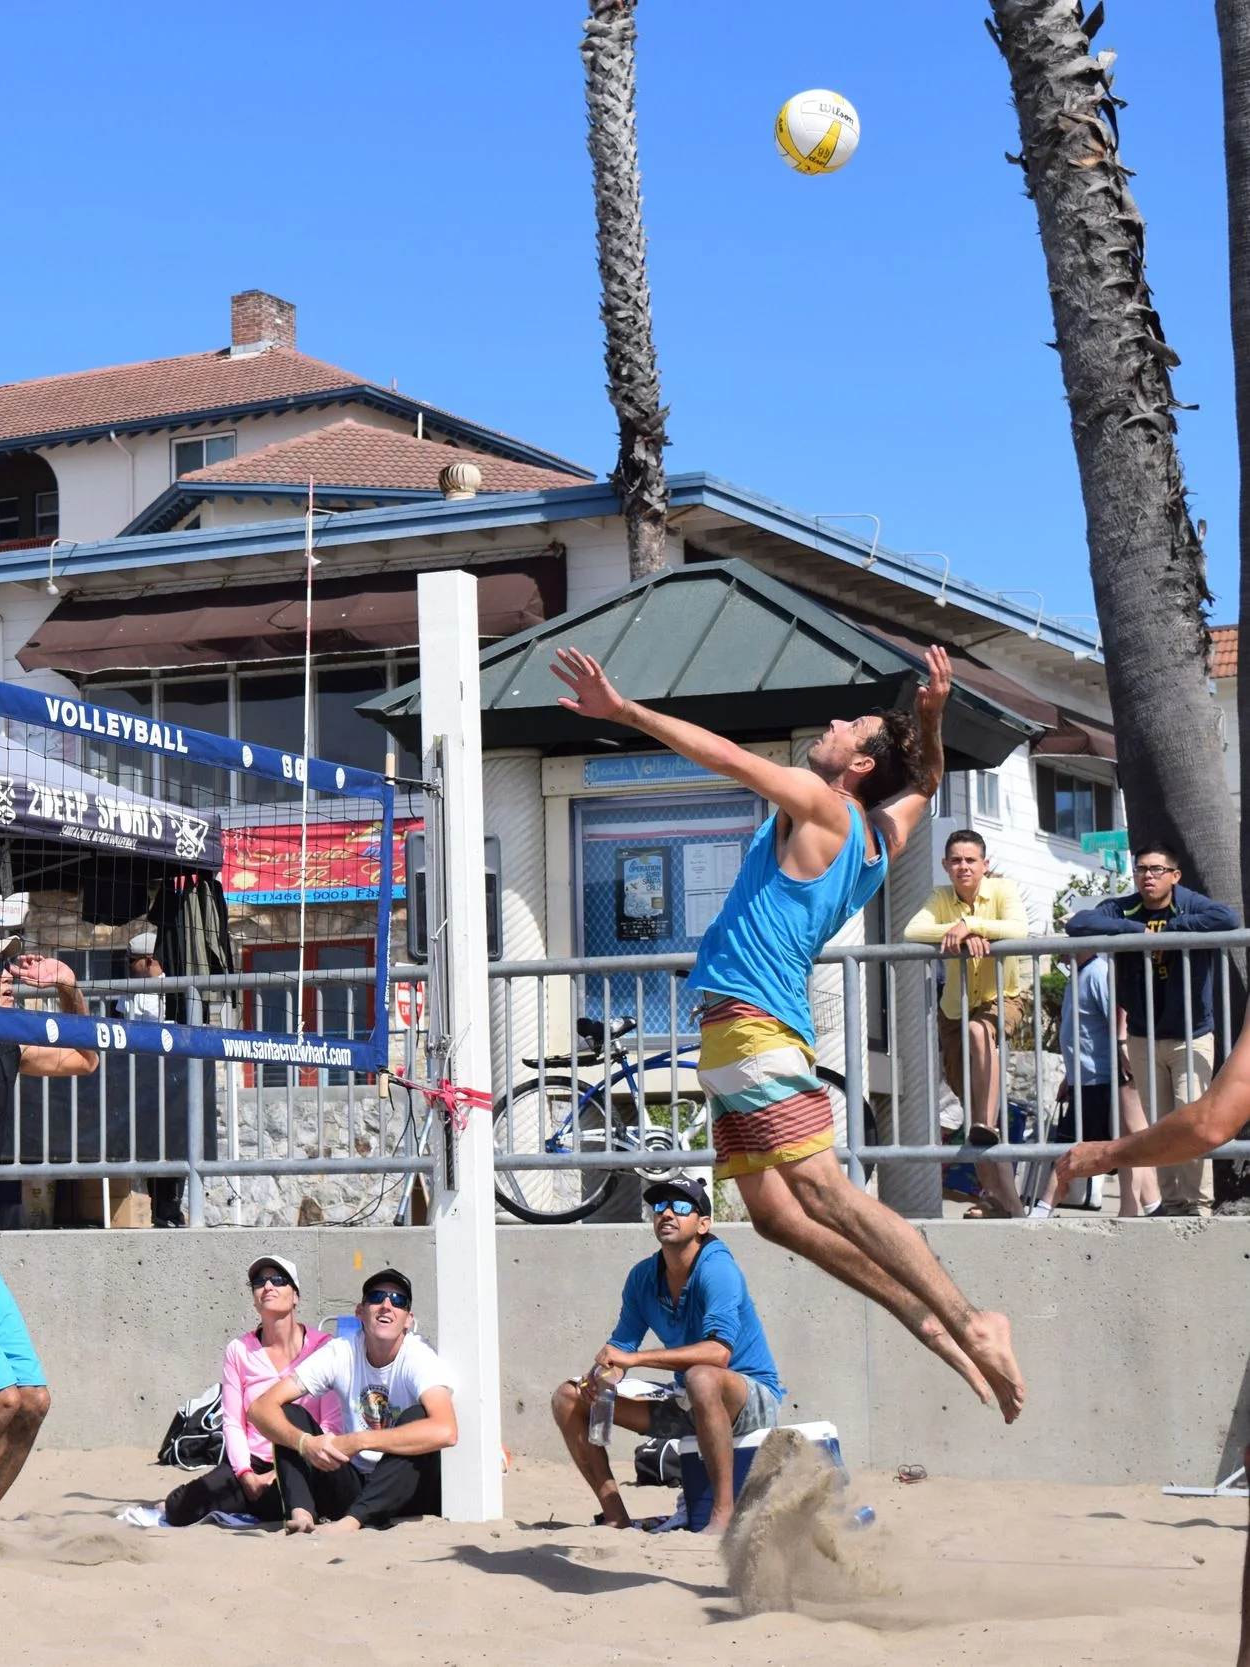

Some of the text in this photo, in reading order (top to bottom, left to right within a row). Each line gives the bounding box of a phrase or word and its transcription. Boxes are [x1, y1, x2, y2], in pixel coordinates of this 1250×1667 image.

[820, 103, 854, 125] Wilson
[45, 697, 188, 754] VOLLEYBALL
[590, 762, 628, 781] Beach
[26, 782, 163, 840] 2DEEP SPORTS
[275, 864, 351, 888] Thai
[221, 1037, 352, 1068] www.santacruzwharf.com
